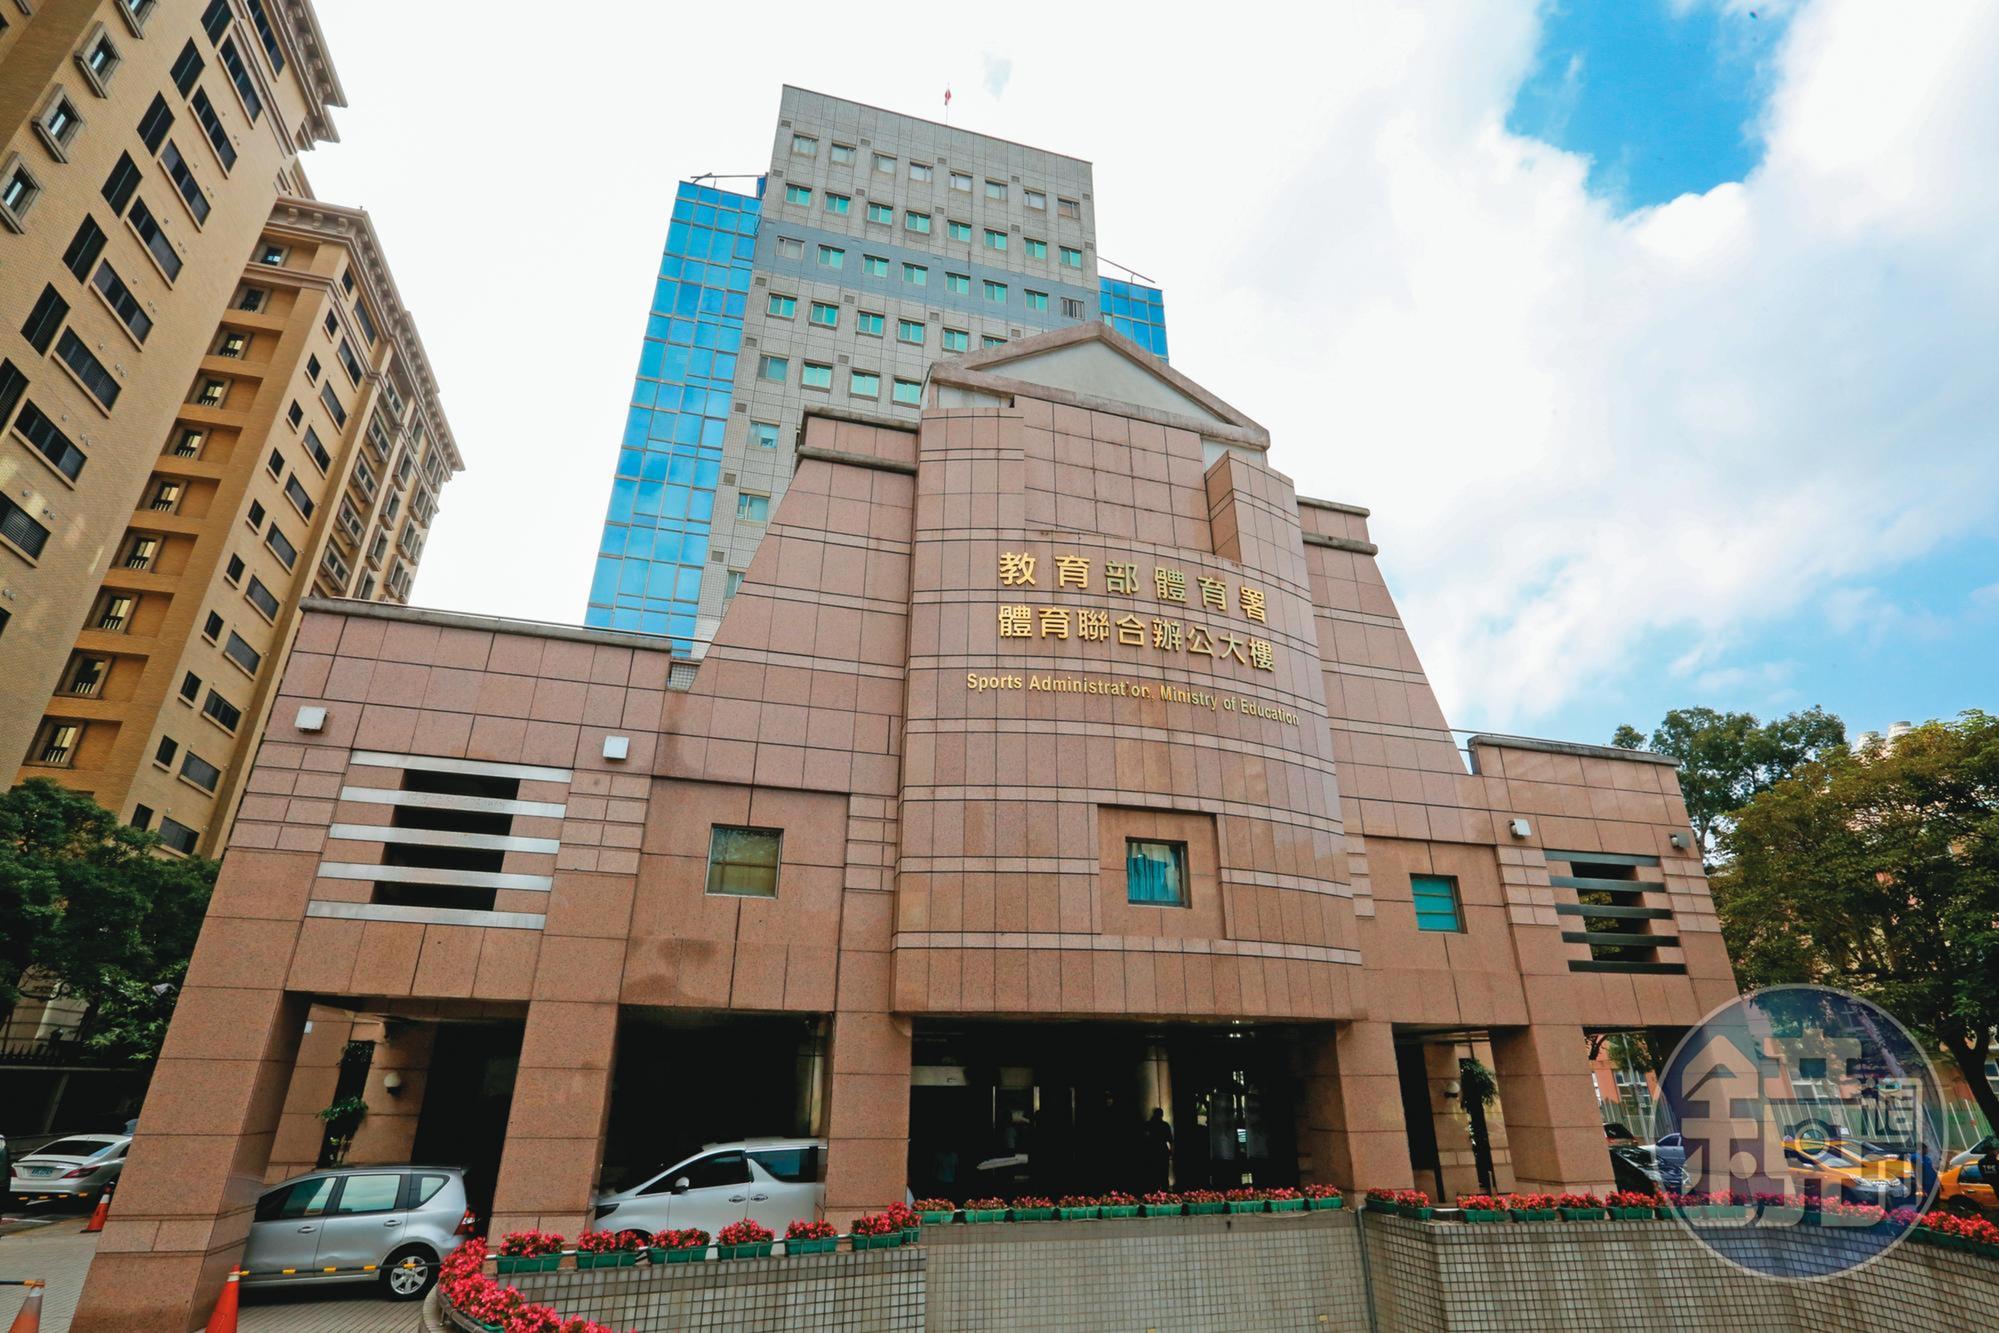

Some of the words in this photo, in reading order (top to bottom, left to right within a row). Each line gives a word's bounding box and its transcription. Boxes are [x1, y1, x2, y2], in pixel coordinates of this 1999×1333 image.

[999, 551, 1267, 624] 教育部體育署
[998, 605, 1276, 673] 體育聯合辦公大樓
[967, 673, 1023, 693] Sports
[1160, 684, 1217, 711] Ministry
[1223, 697, 1236, 711] of
[1241, 698, 1300, 726] Education
